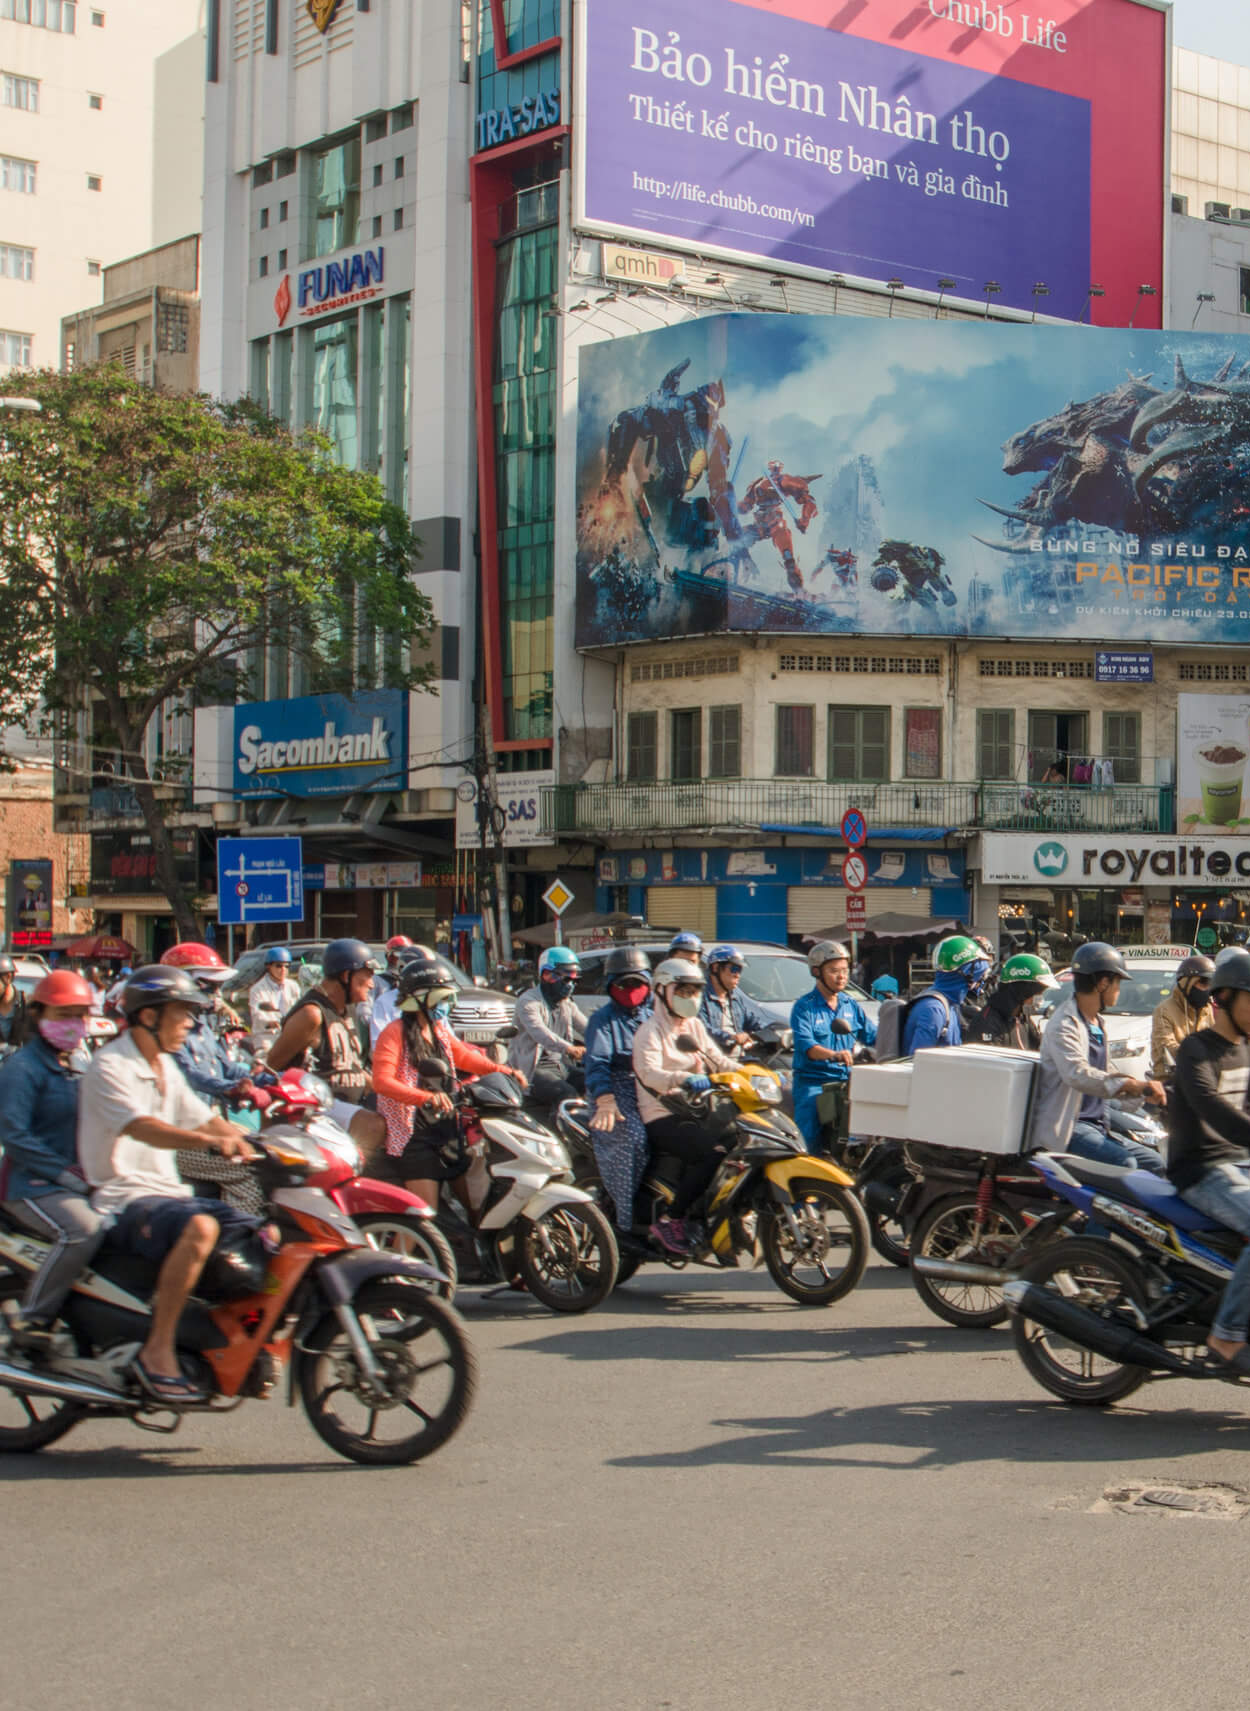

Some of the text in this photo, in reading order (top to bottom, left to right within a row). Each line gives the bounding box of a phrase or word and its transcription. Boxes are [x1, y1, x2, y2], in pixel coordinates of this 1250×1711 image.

[1020, 14, 1067, 53] Life
[477, 88, 560, 149] TRA-SAS
[631, 26, 1010, 172] Bảo hiểm Nhân thọ
[629, 94, 1009, 208] Thiết kế cho riêng bạn và gia đình
[632, 171, 816, 228] http://life.chubb.com/vn
[298, 246, 384, 308] FUNAN
[615, 255, 657, 276] qmh
[1029, 537, 1096, 553] BÙNG
[1151, 541, 1205, 557] SIÊU
[1075, 562, 1220, 587] PACIFIC
[238, 716, 391, 774] Sacombank
[952, 950, 971, 962] Grab
[1009, 967, 1031, 976] Grab
[1128, 948, 1189, 957] VINASUN TAXI
